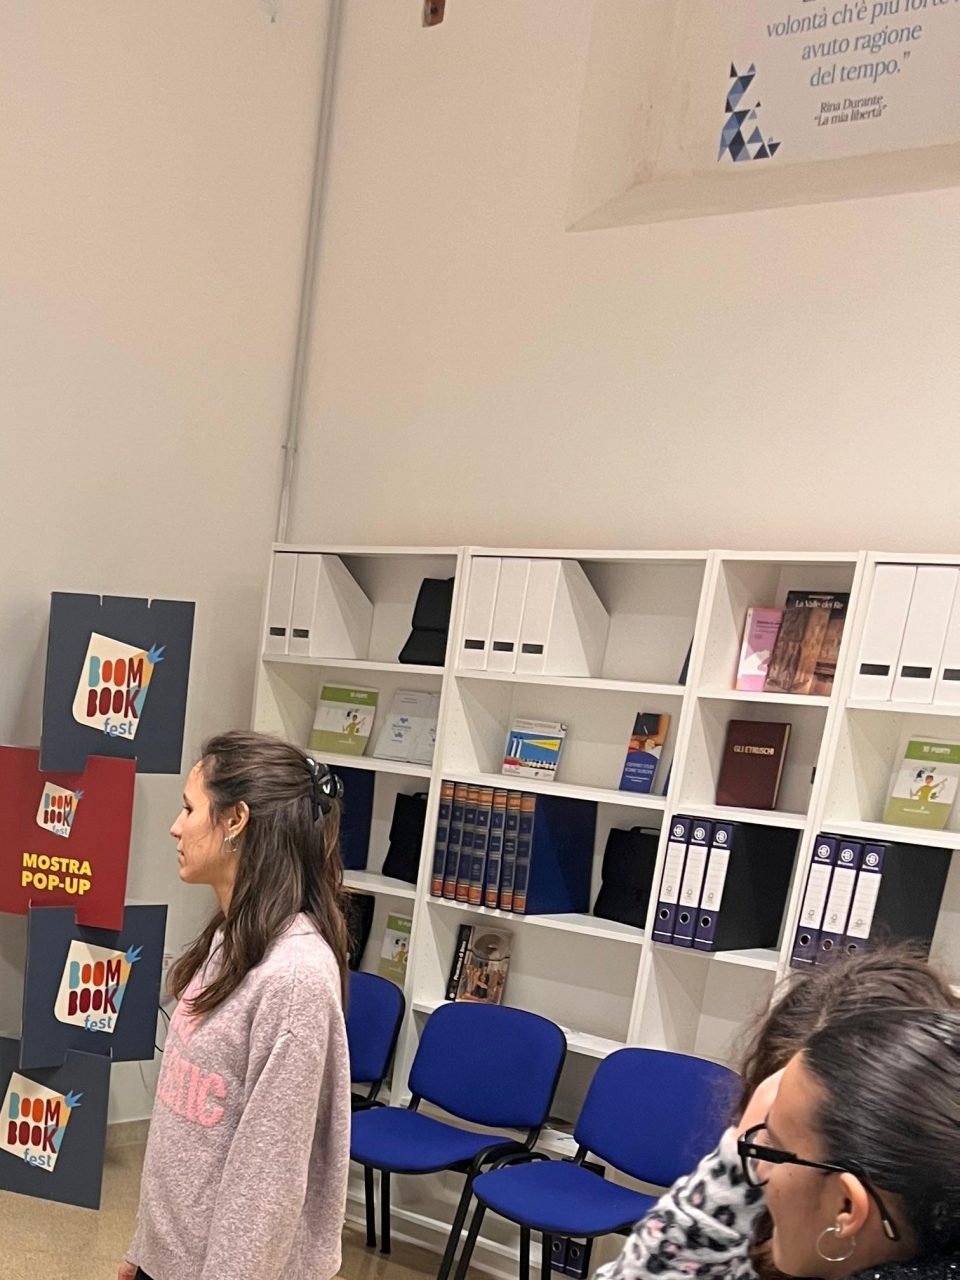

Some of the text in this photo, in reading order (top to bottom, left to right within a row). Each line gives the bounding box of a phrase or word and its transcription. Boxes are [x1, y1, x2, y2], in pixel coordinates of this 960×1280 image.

[767, 7, 828, 37] volontà
[831, 0, 868, 26] ch'è
[802, 25, 922, 60] avuto ragione
[810, 64, 836, 86] del
[820, 95, 884, 114] Rina Durante
[831, 110, 849, 123] mia
[88, 655, 144, 689] BOOM
[86, 687, 141, 719] BOOK
[103, 717, 133, 737] fest
[733, 745, 775, 755] GLI ETRUSCHI
[43, 808, 71, 827] BOOK
[23, 852, 93, 877] MOSTRA
[21, 870, 91, 895] POP-UP
[69, 959, 122, 990] BOOM
[67, 987, 118, 1016] BOOK
[84, 1015, 113, 1032] fest
[8, 1092, 61, 1128] BOOM
[7, 1121, 58, 1154] BOOK
[23, 1148, 52, 1168] fest
